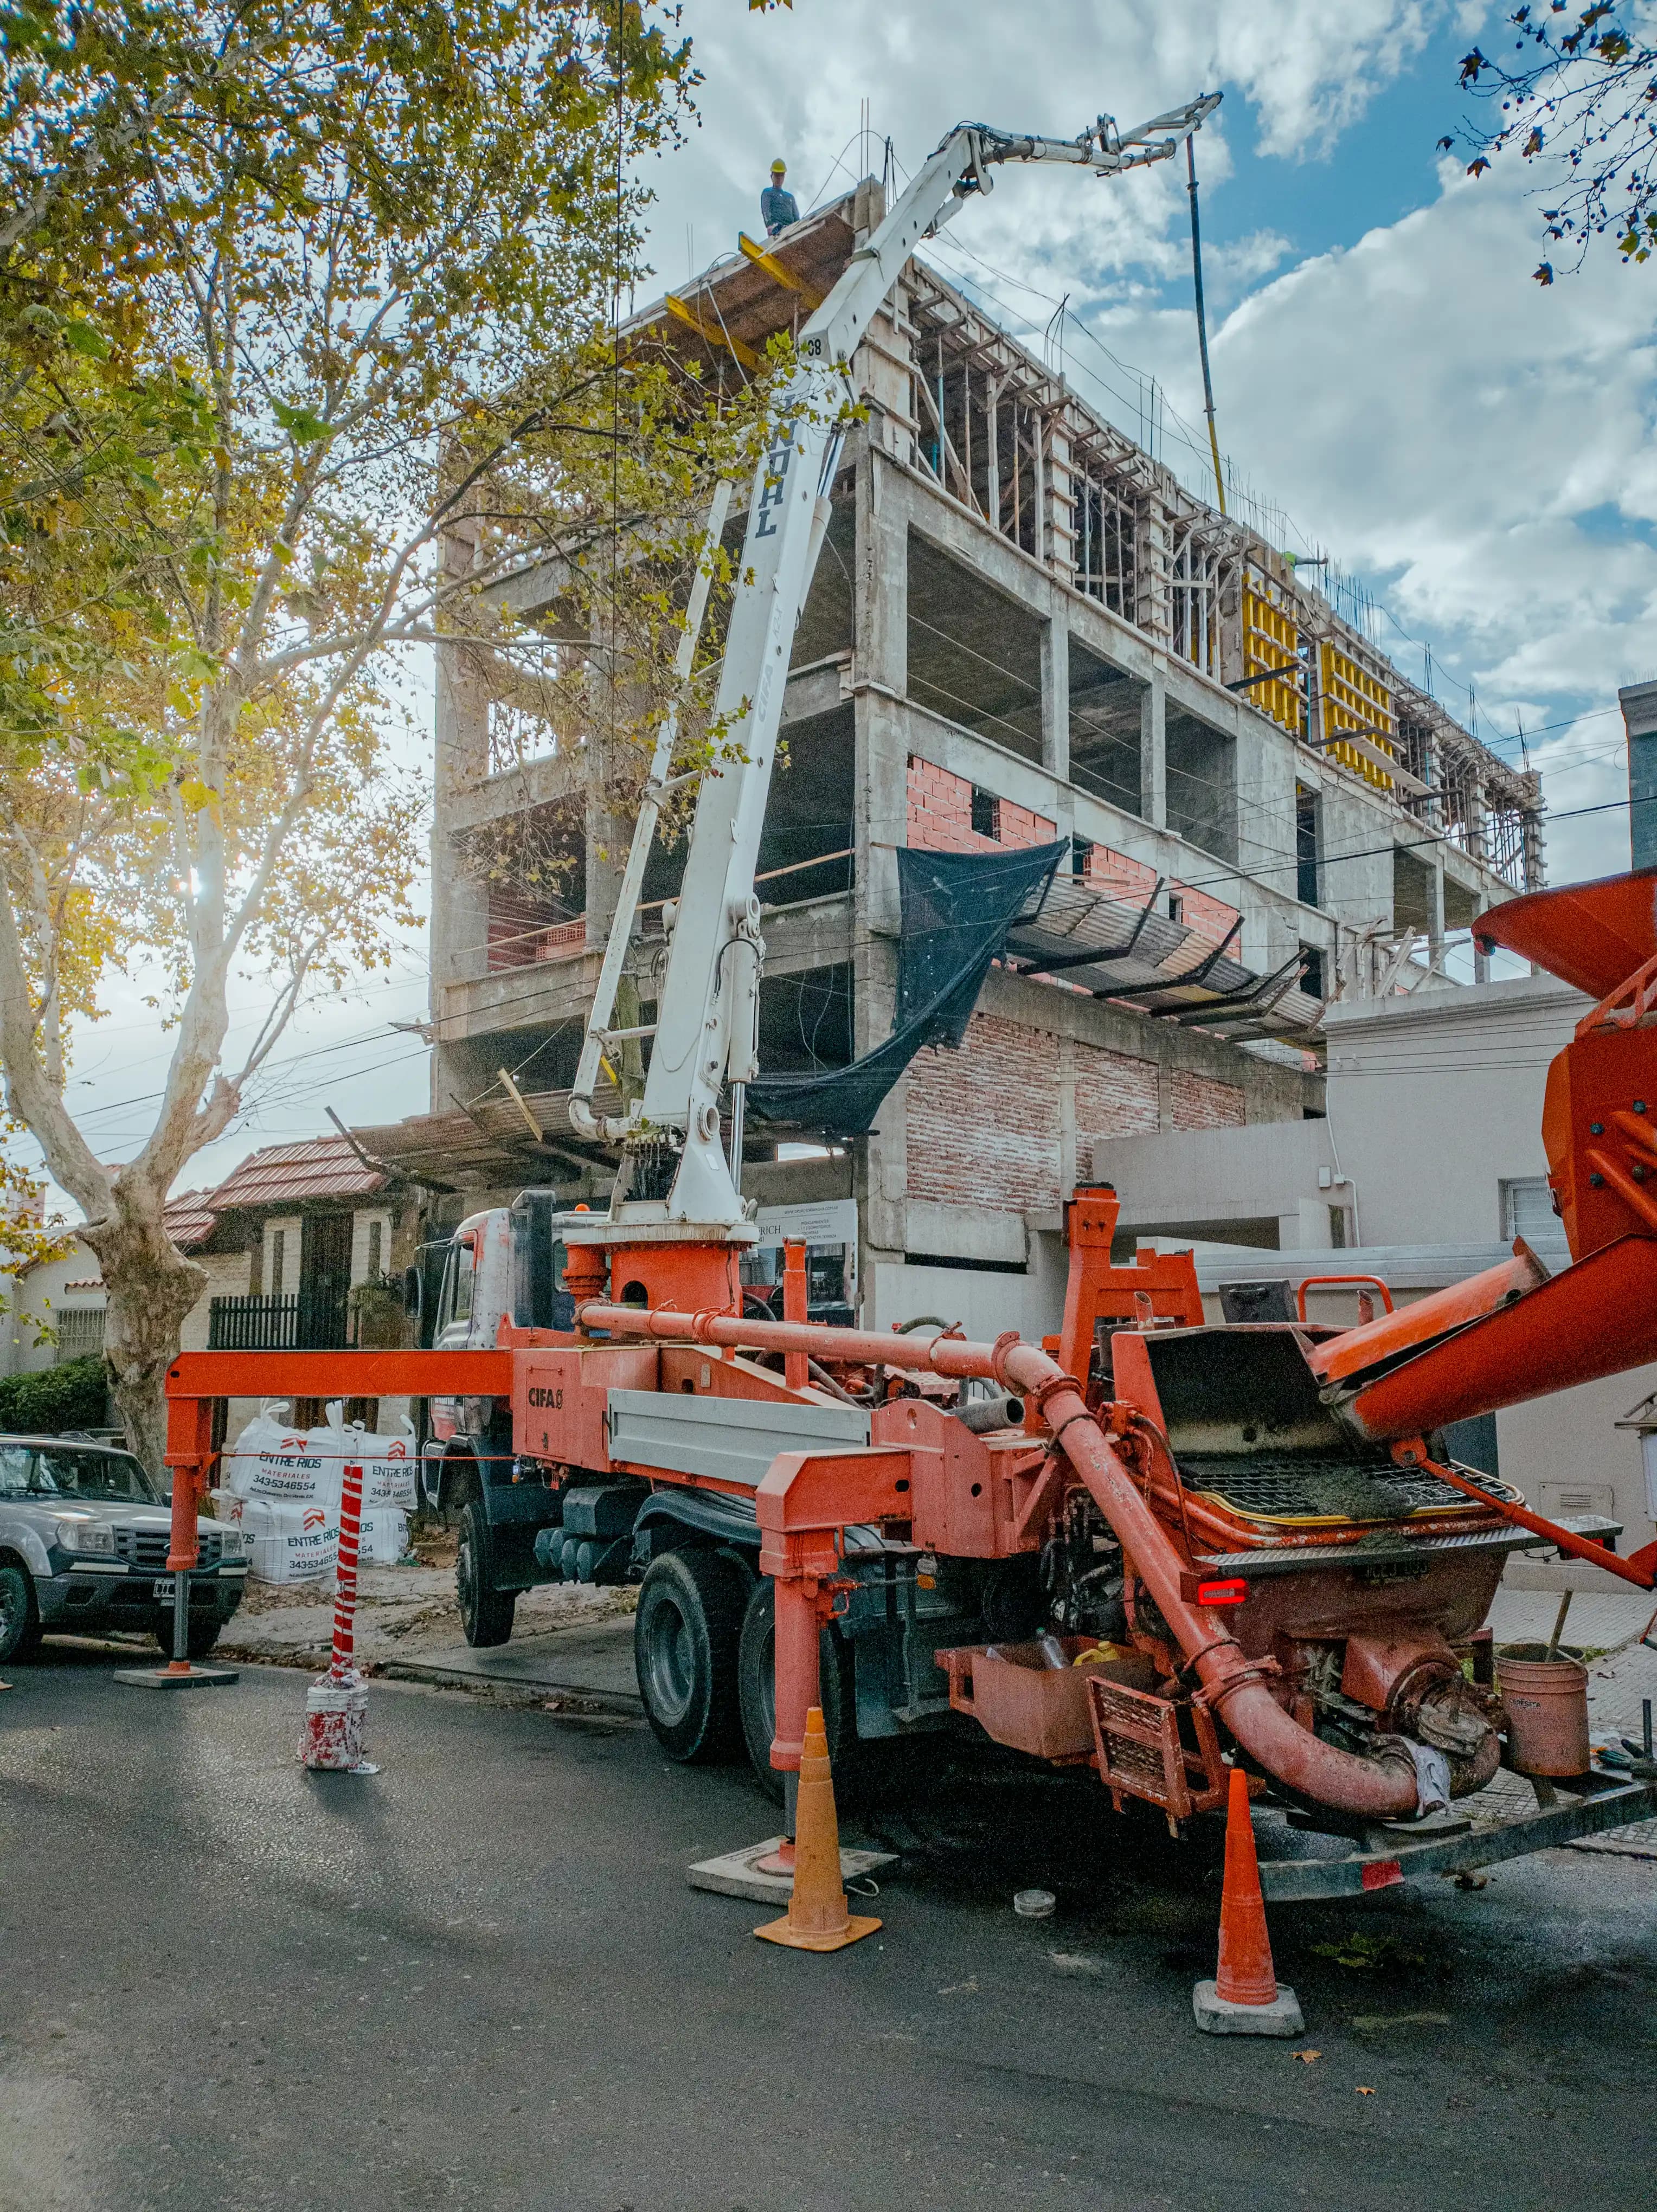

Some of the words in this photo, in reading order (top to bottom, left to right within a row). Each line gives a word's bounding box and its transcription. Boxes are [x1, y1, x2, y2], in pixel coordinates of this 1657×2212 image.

[759, 1225, 781, 1236] RICH
[259, 1450, 296, 1467] ENTRE
[261, 1468, 311, 1479] MATERIALES
[372, 1465, 401, 1477] ENTRE
[253, 1474, 316, 1491] 343-5346554
[360, 1522, 373, 1533] OS
[287, 1534, 322, 1547] ENTRE
[295, 1544, 336, 1558] MATERIALES
[289, 1552, 339, 1569] 343-534655
